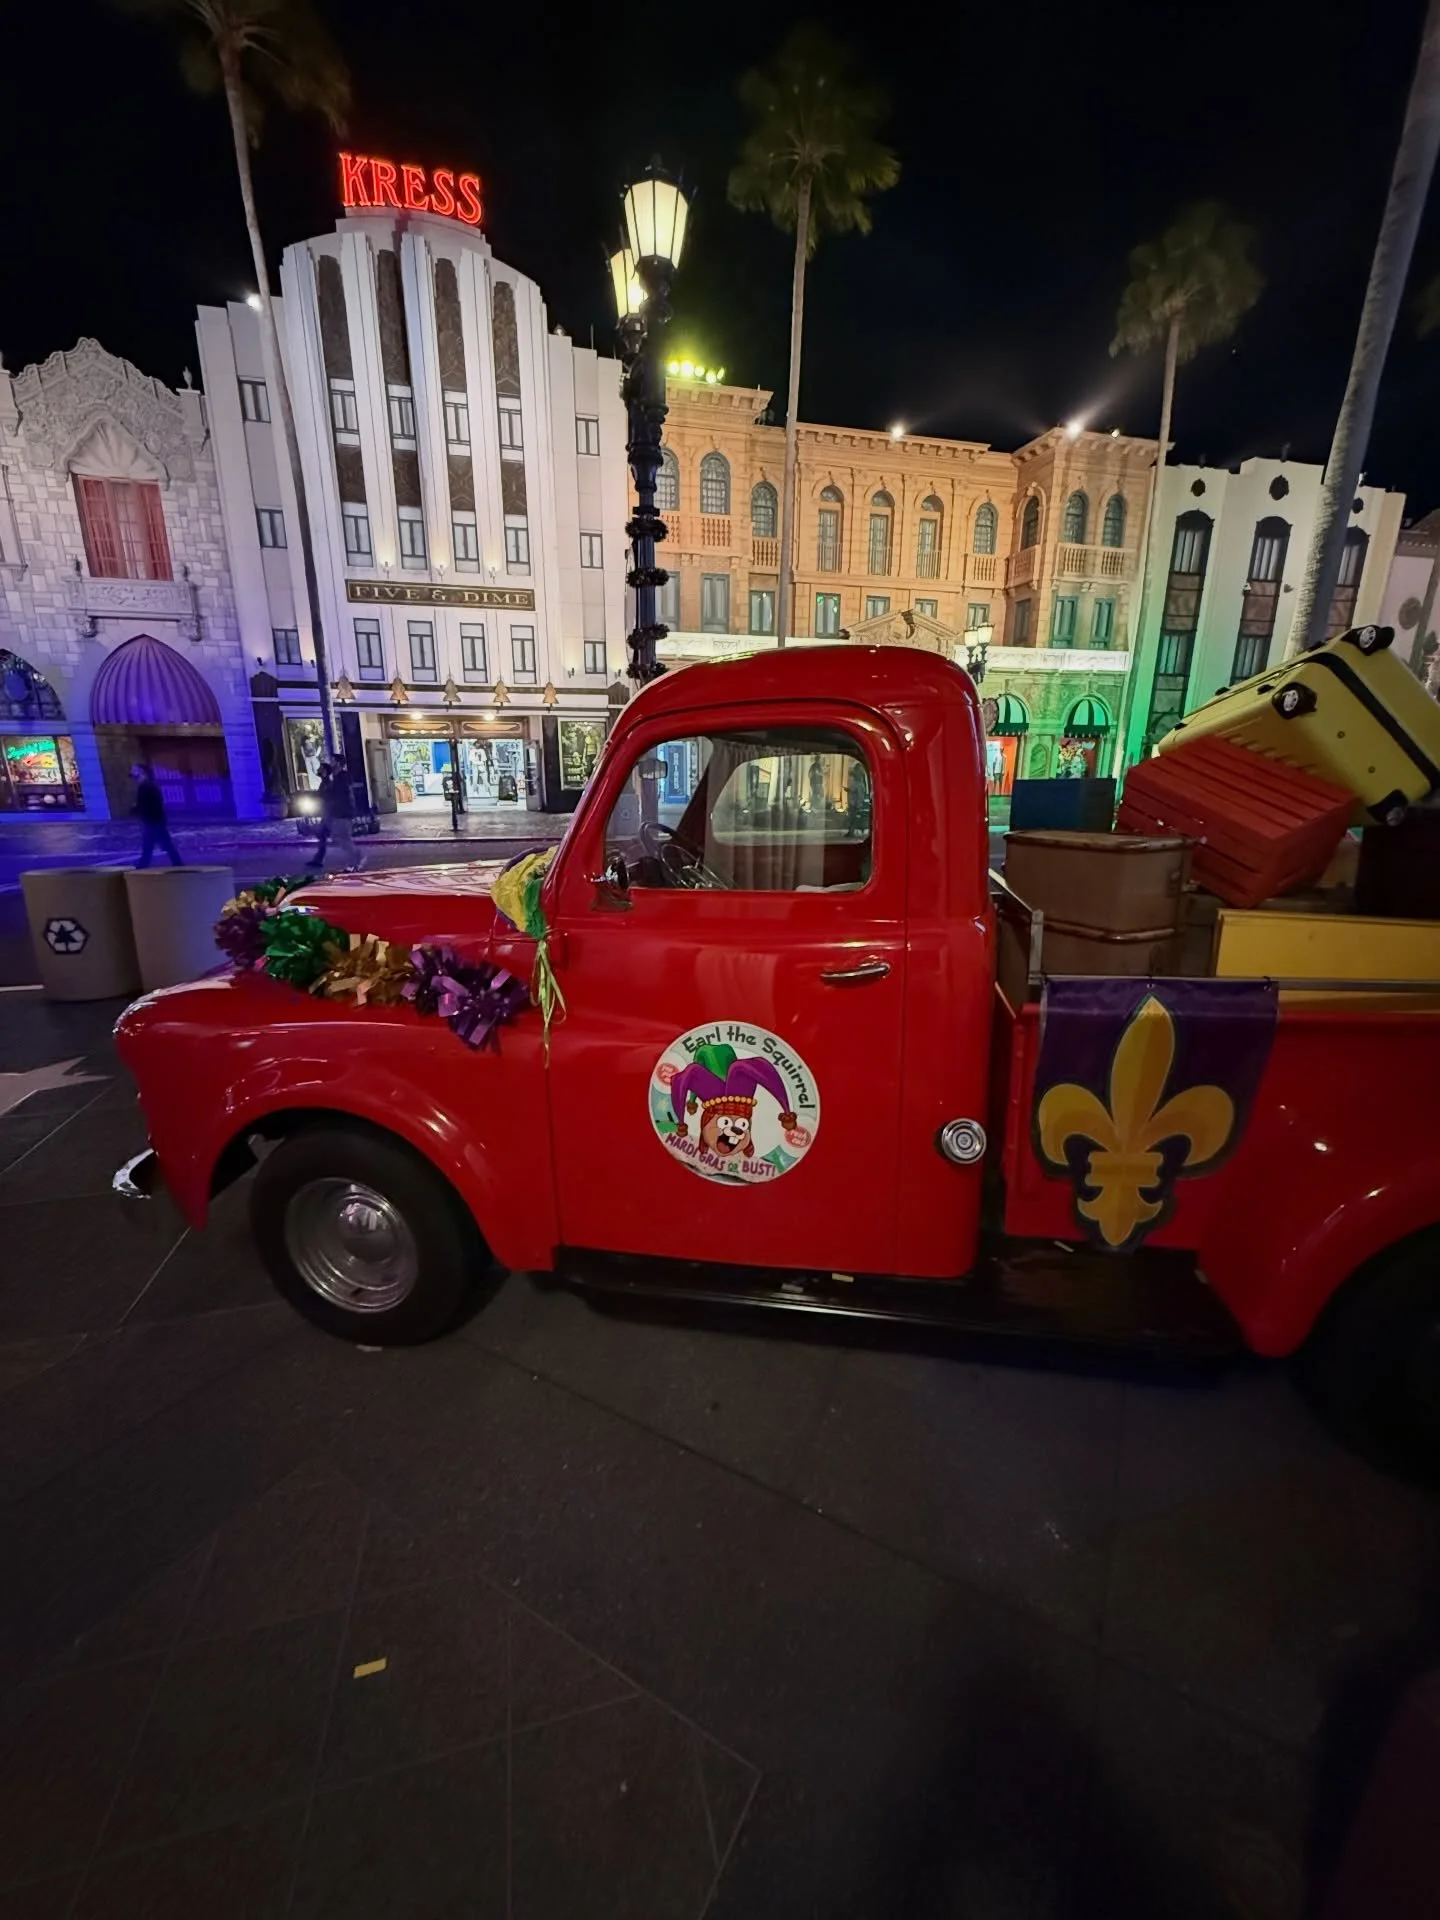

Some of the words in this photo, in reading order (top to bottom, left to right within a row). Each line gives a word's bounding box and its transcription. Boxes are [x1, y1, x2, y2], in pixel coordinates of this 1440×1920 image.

[339, 153, 482, 224] KRESS
[355, 586, 420, 600] FIVE
[432, 589, 446, 601] &
[464, 591, 529, 605] DIME
[682, 1026, 721, 1053] Earl
[727, 1026, 757, 1046] the
[762, 1038, 816, 1109] Squirrel
[665, 1133, 699, 1158] MARDI
[699, 1150, 725, 1171] GRAS
[742, 1161, 776, 1176] BUST!
